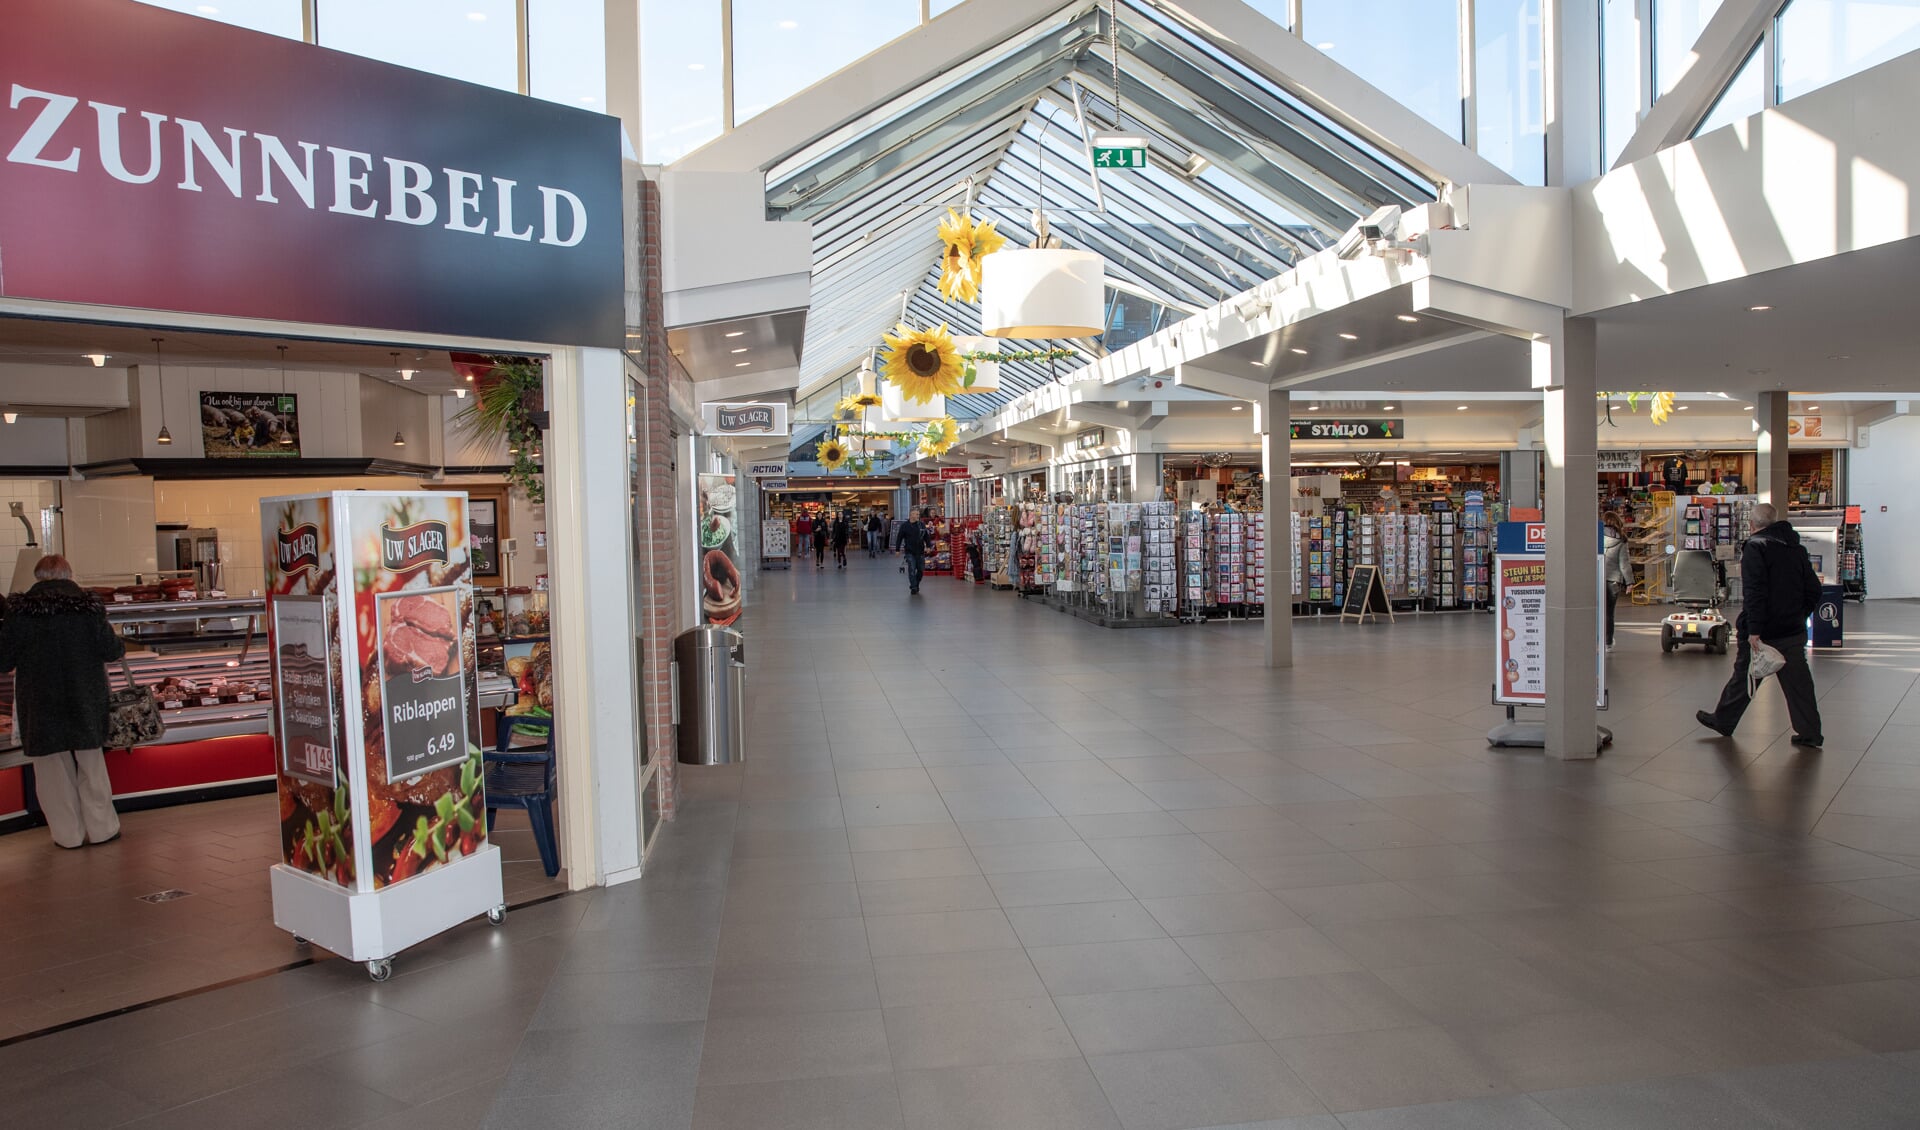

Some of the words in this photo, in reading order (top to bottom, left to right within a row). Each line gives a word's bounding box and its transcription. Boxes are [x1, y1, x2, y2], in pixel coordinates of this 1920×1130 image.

[7, 83, 588, 248] ZUNNEBELD
[721, 414, 736, 426] UW
[739, 411, 769, 425] SLAGER
[752, 465, 783, 473] ACTION
[280, 541, 292, 564] UW
[293, 533, 318, 562] SLAGER
[385, 538, 405, 561] UW
[408, 530, 445, 558] SLAGER
[1503, 566, 1529, 577] STEUN
[1530, 565, 1545, 574] HET
[393, 696, 456, 723] Riblappen
[427, 732, 455, 755] 6.49
